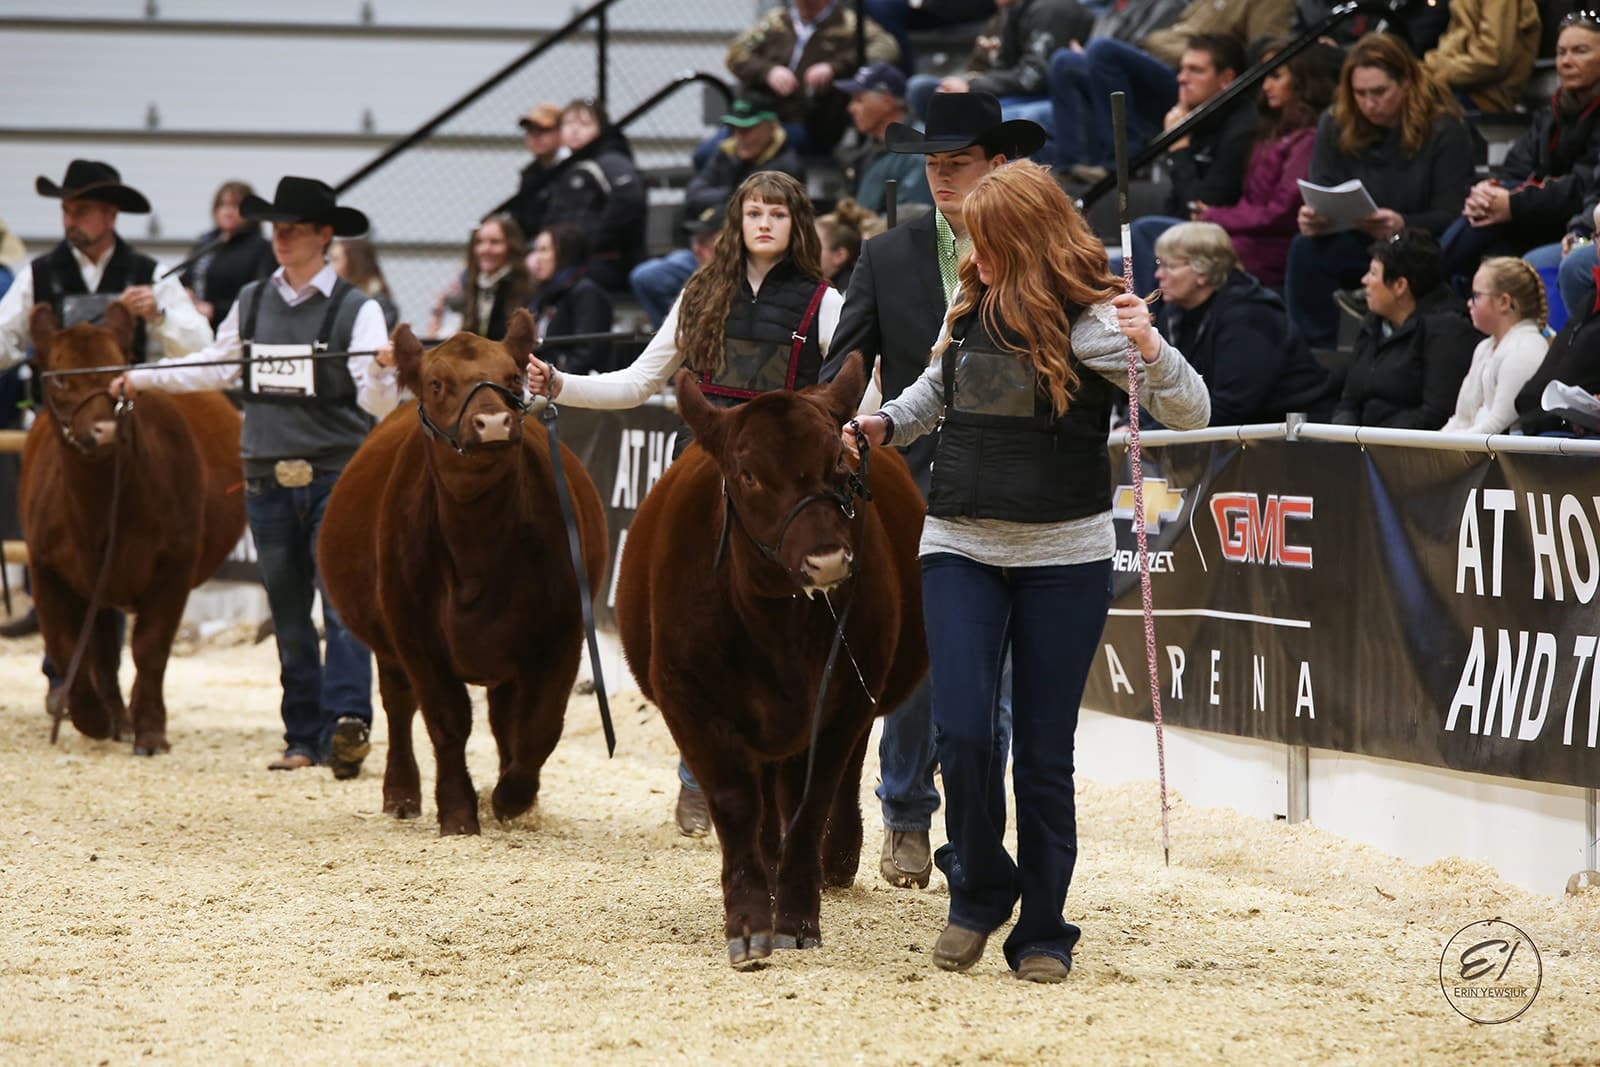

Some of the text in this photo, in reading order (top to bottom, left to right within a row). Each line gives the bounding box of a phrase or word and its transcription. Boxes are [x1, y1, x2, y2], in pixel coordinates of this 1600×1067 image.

[611, 428, 645, 510] AT
[1209, 492, 1314, 569] GMC
[1455, 488, 1600, 604] AT HO
[1104, 643, 1316, 719] ARENA
[1444, 626, 1557, 741] AND
